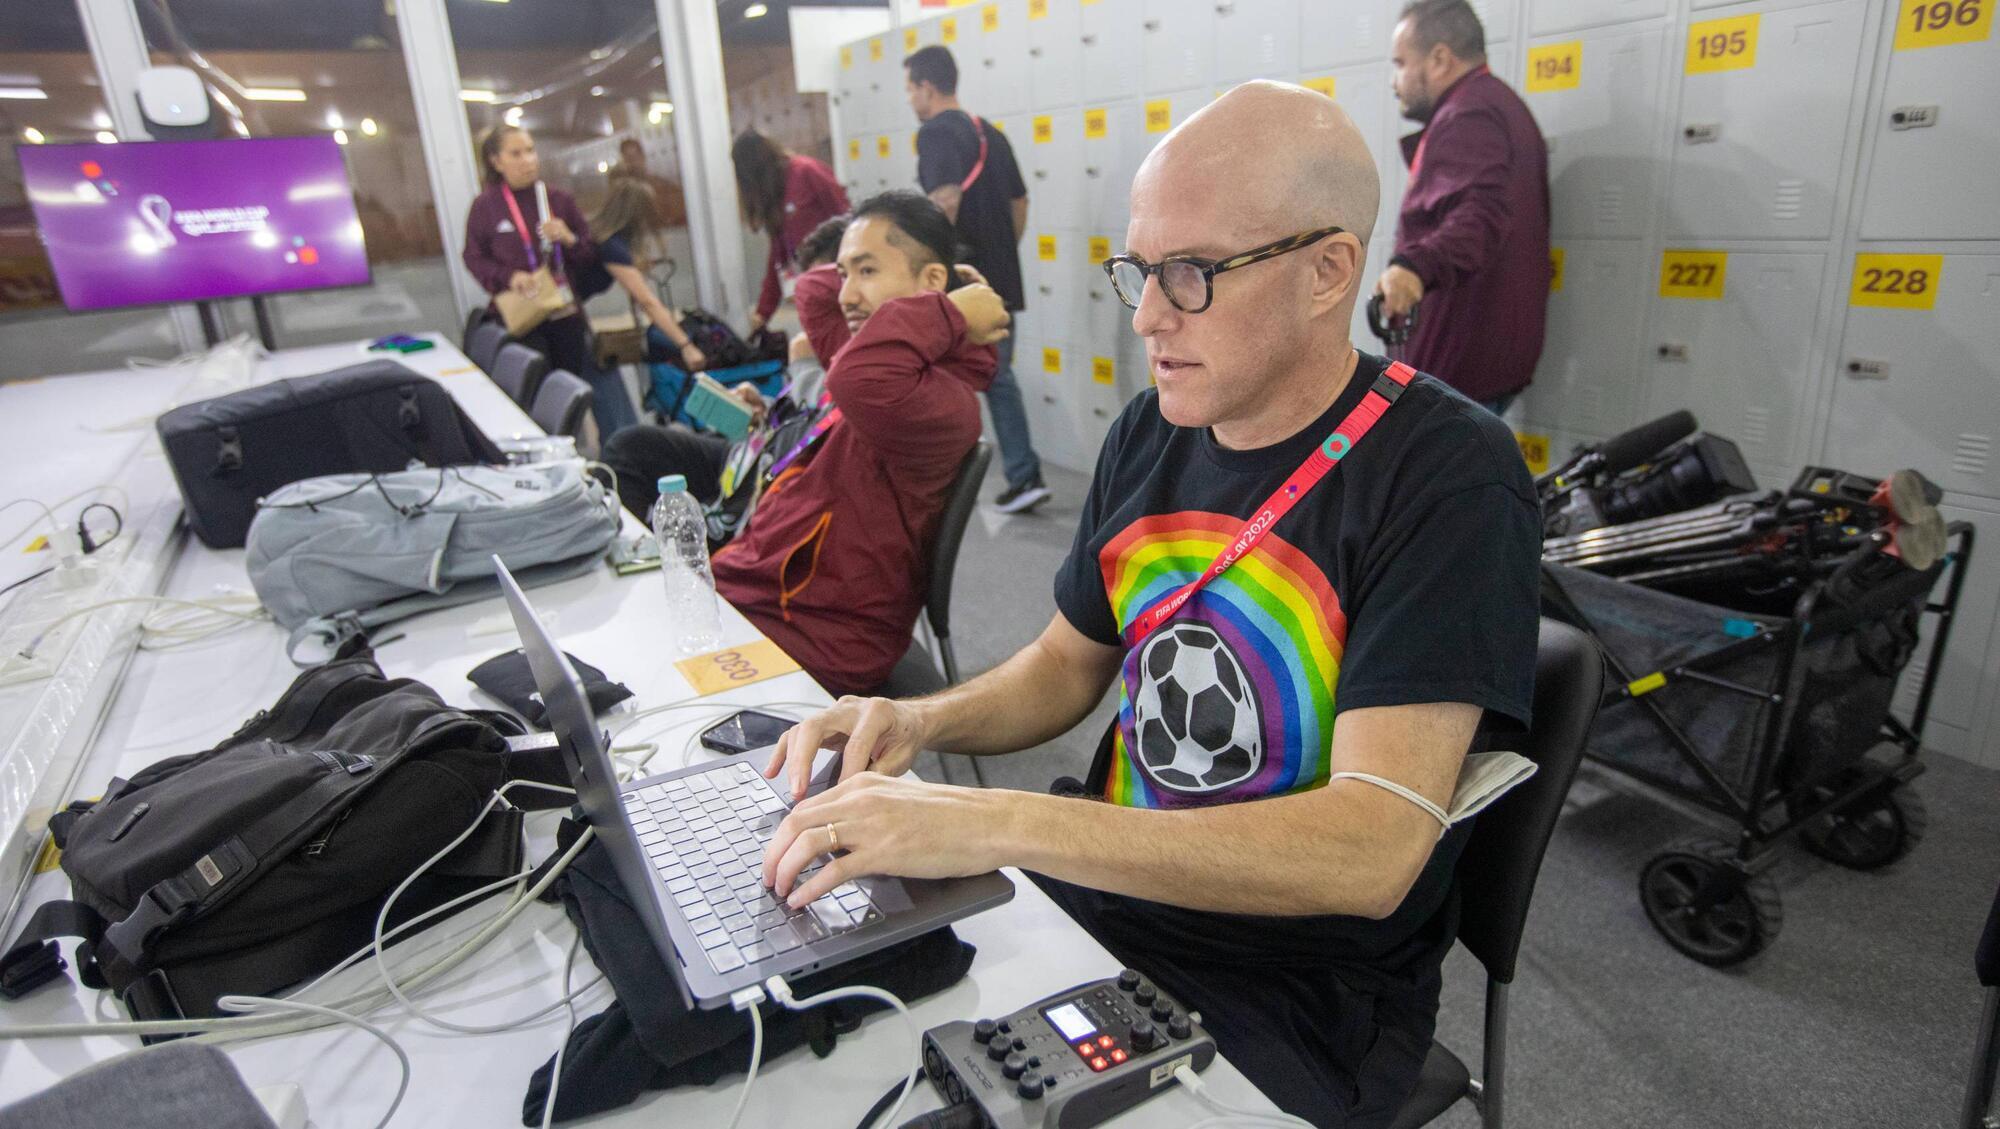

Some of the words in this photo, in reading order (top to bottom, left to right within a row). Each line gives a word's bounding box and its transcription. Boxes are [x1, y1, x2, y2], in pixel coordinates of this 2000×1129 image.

[1911, 0, 1982, 33] 196
[1696, 30, 1747, 60] 195
[1534, 55, 1574, 80] 194
[1668, 263, 1717, 287] 227
[1861, 268, 1929, 295] 228
[1155, 603, 1171, 620] FIFA
[714, 652, 759, 680] 030
